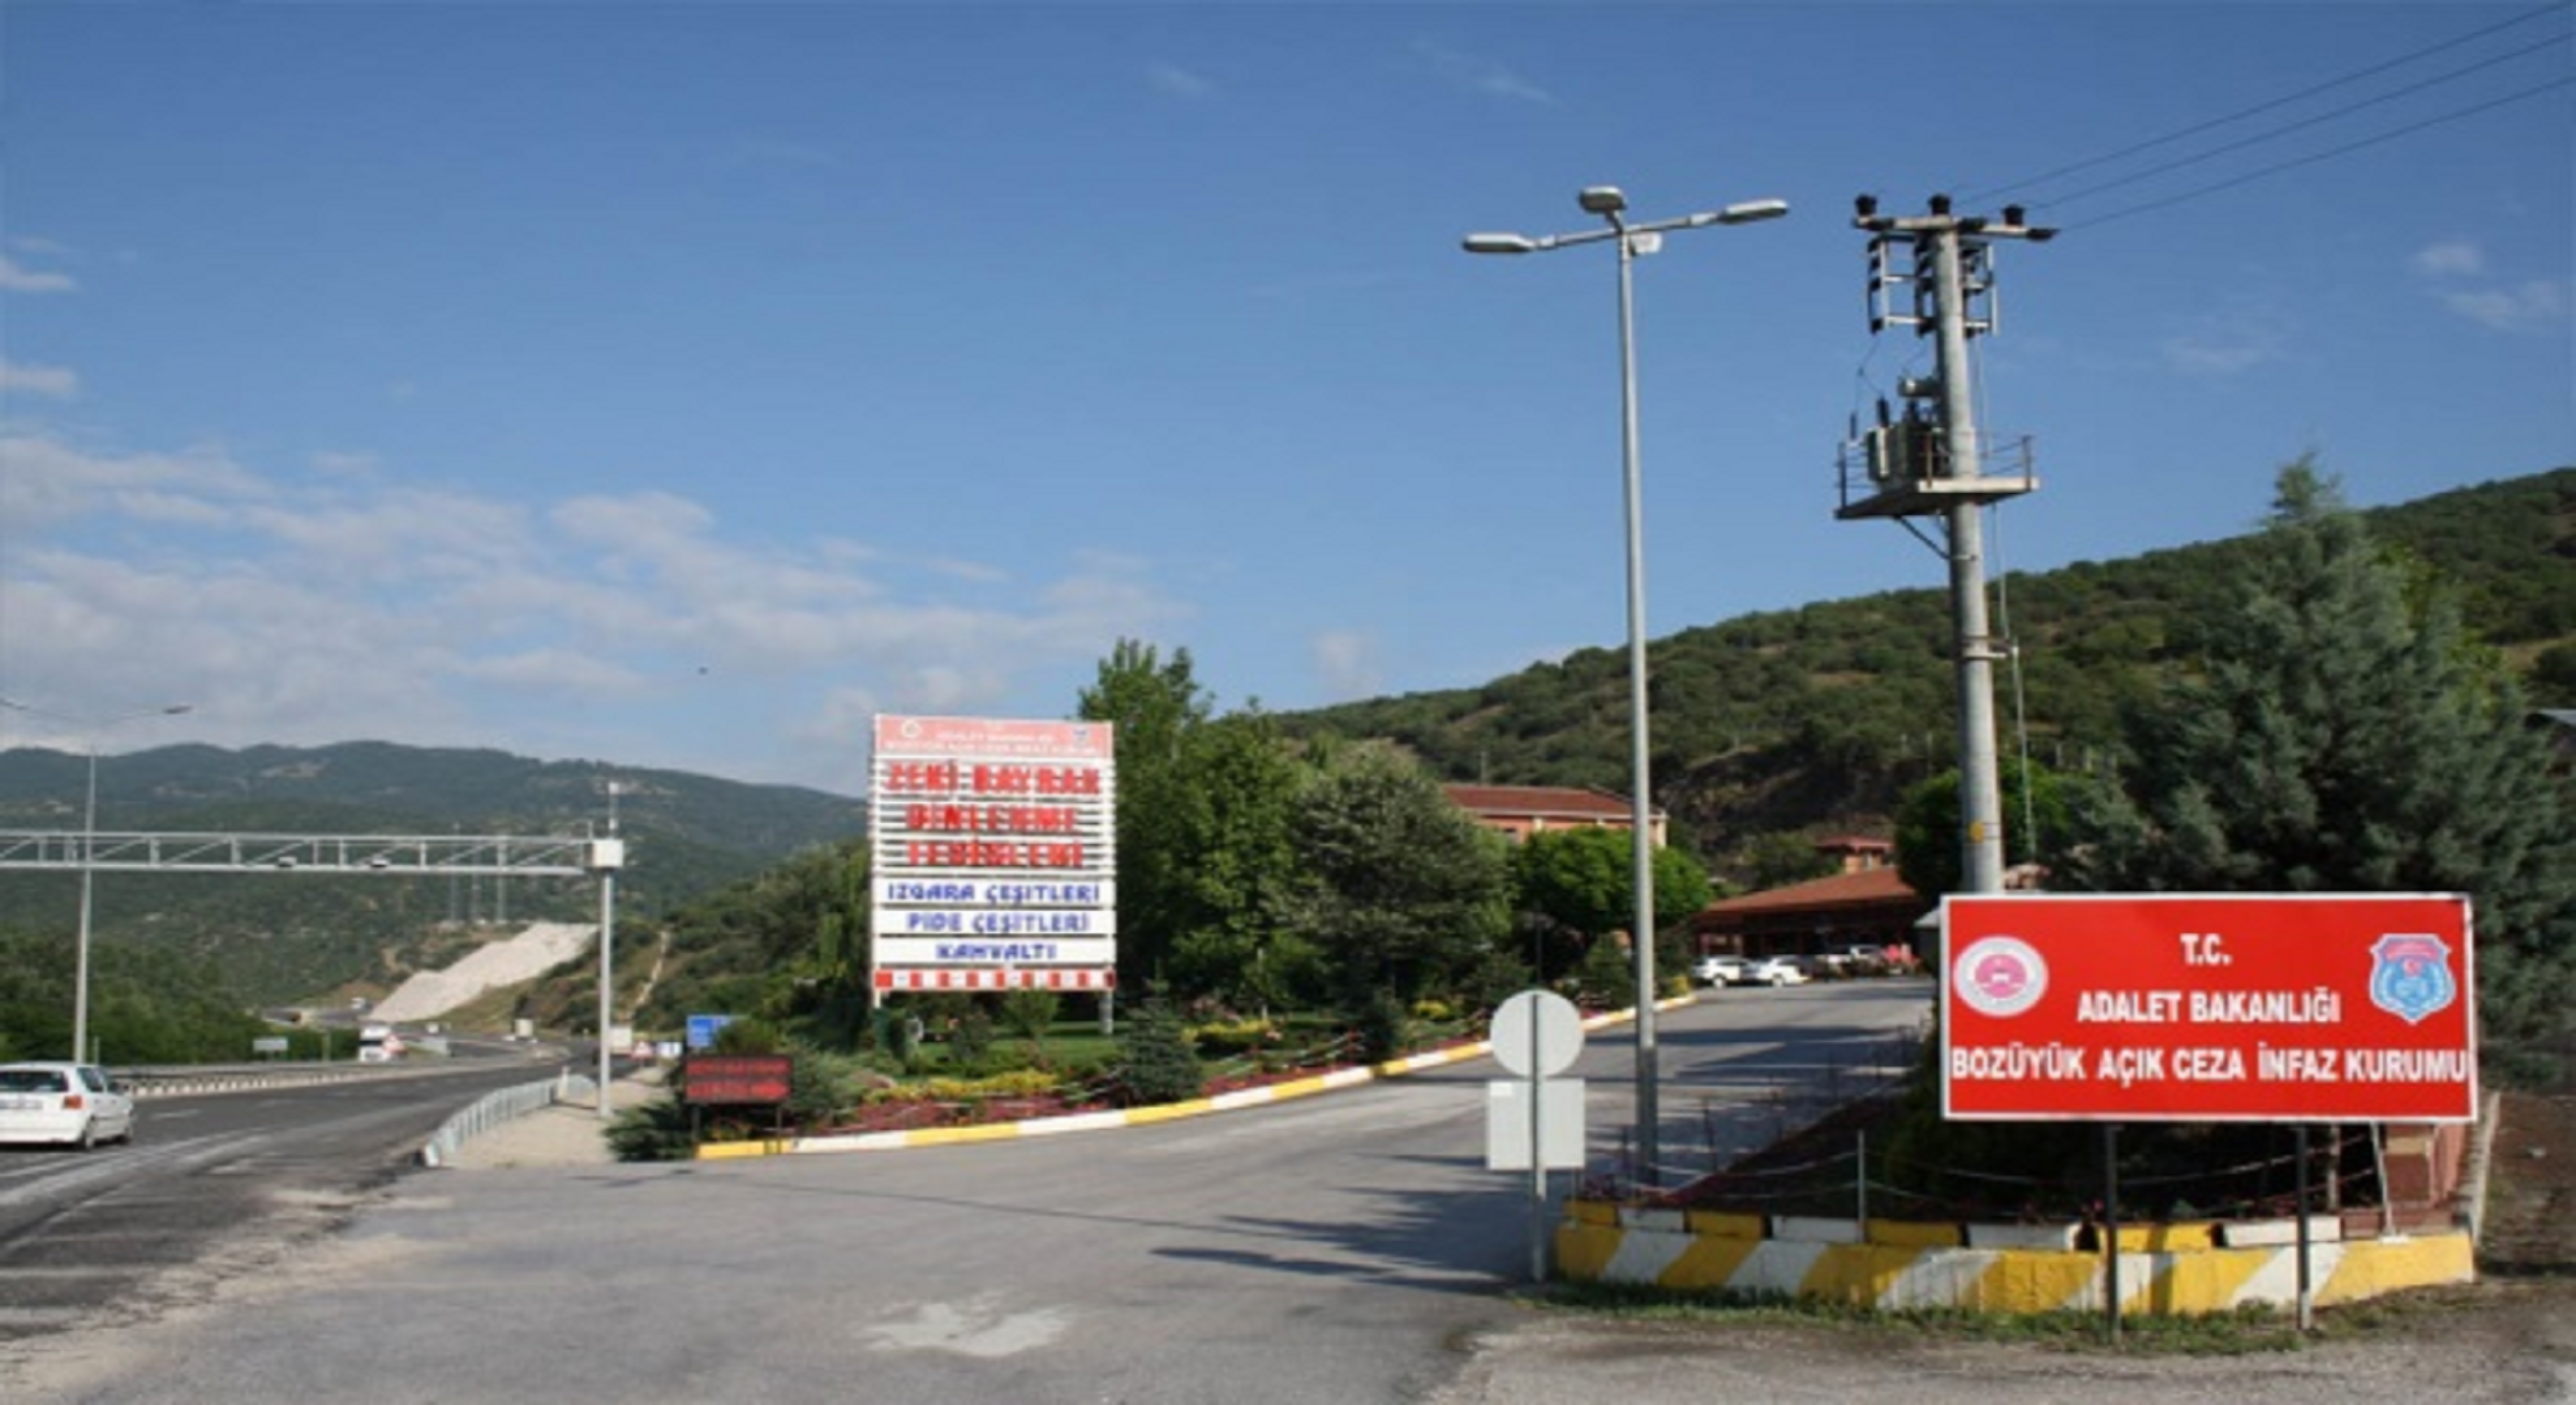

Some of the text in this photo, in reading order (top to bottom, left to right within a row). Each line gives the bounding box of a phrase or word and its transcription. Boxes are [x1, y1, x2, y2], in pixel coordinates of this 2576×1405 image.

[2181, 933, 2232, 965] T.C.
[2077, 986, 2342, 1024] ADALET BAKANLIĞI
[1951, 1042, 2466, 1088] BOZÜYÜK AÇIK CEZA İNFAZ KURUMU
